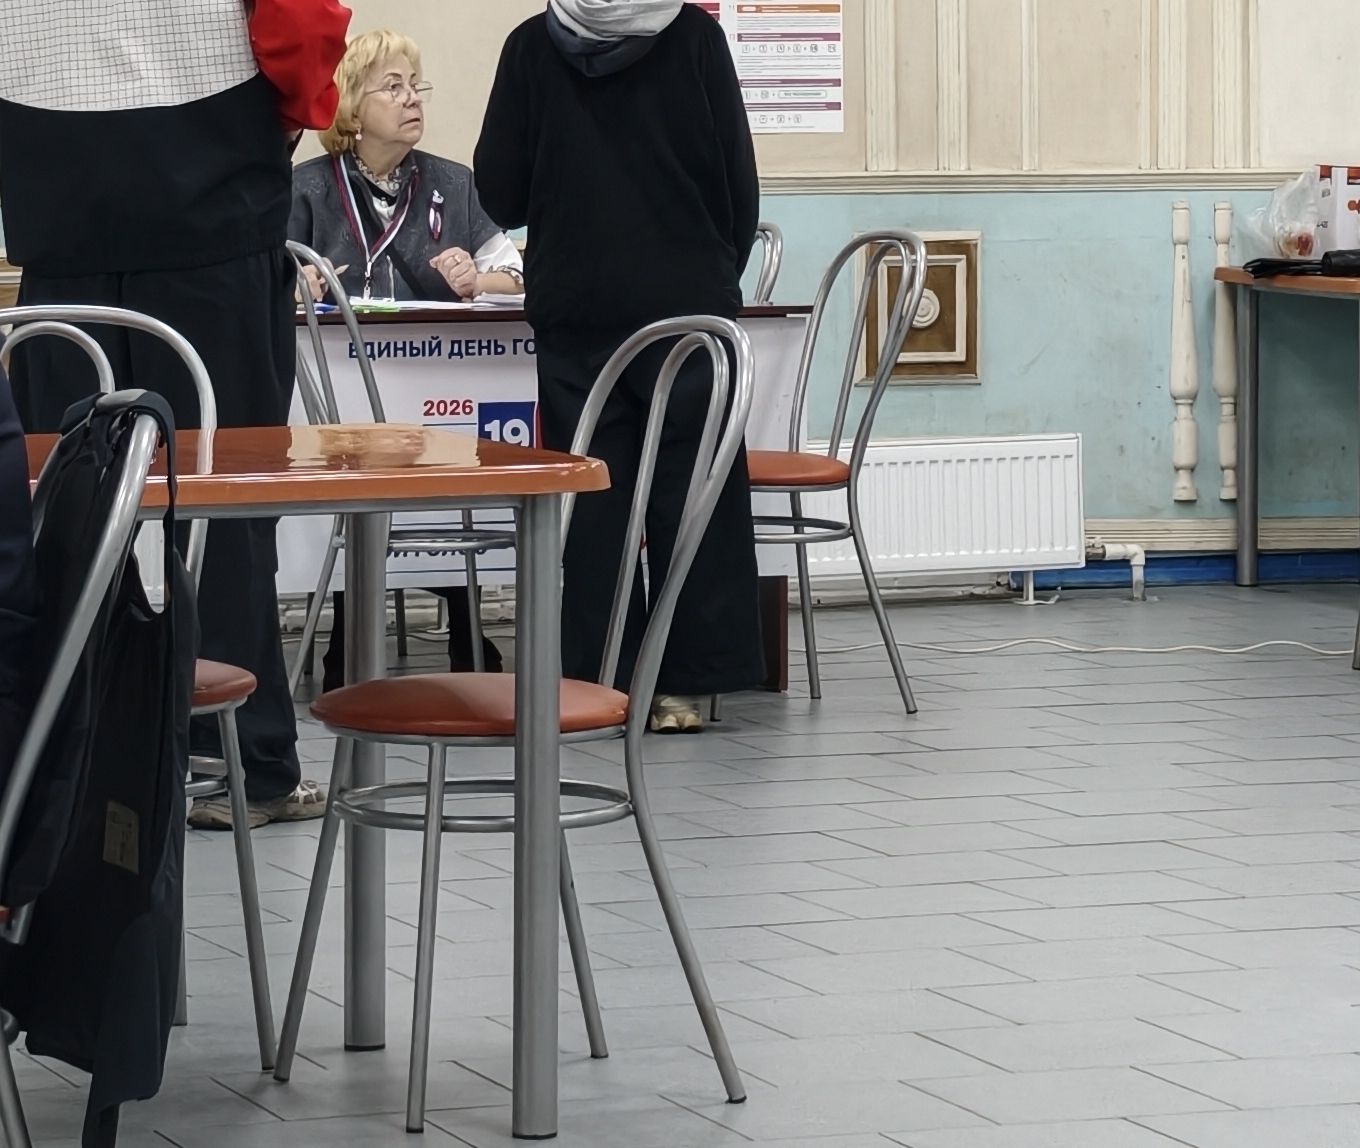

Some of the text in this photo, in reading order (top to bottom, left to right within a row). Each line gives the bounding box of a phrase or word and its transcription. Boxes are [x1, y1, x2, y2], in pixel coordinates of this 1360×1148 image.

[348, 335, 442, 361] ЕДИНЫЙ
[447, 338, 506, 360] ДЕНЬ
[423, 399, 474, 417] 2026
[484, 418, 530, 447] 19
